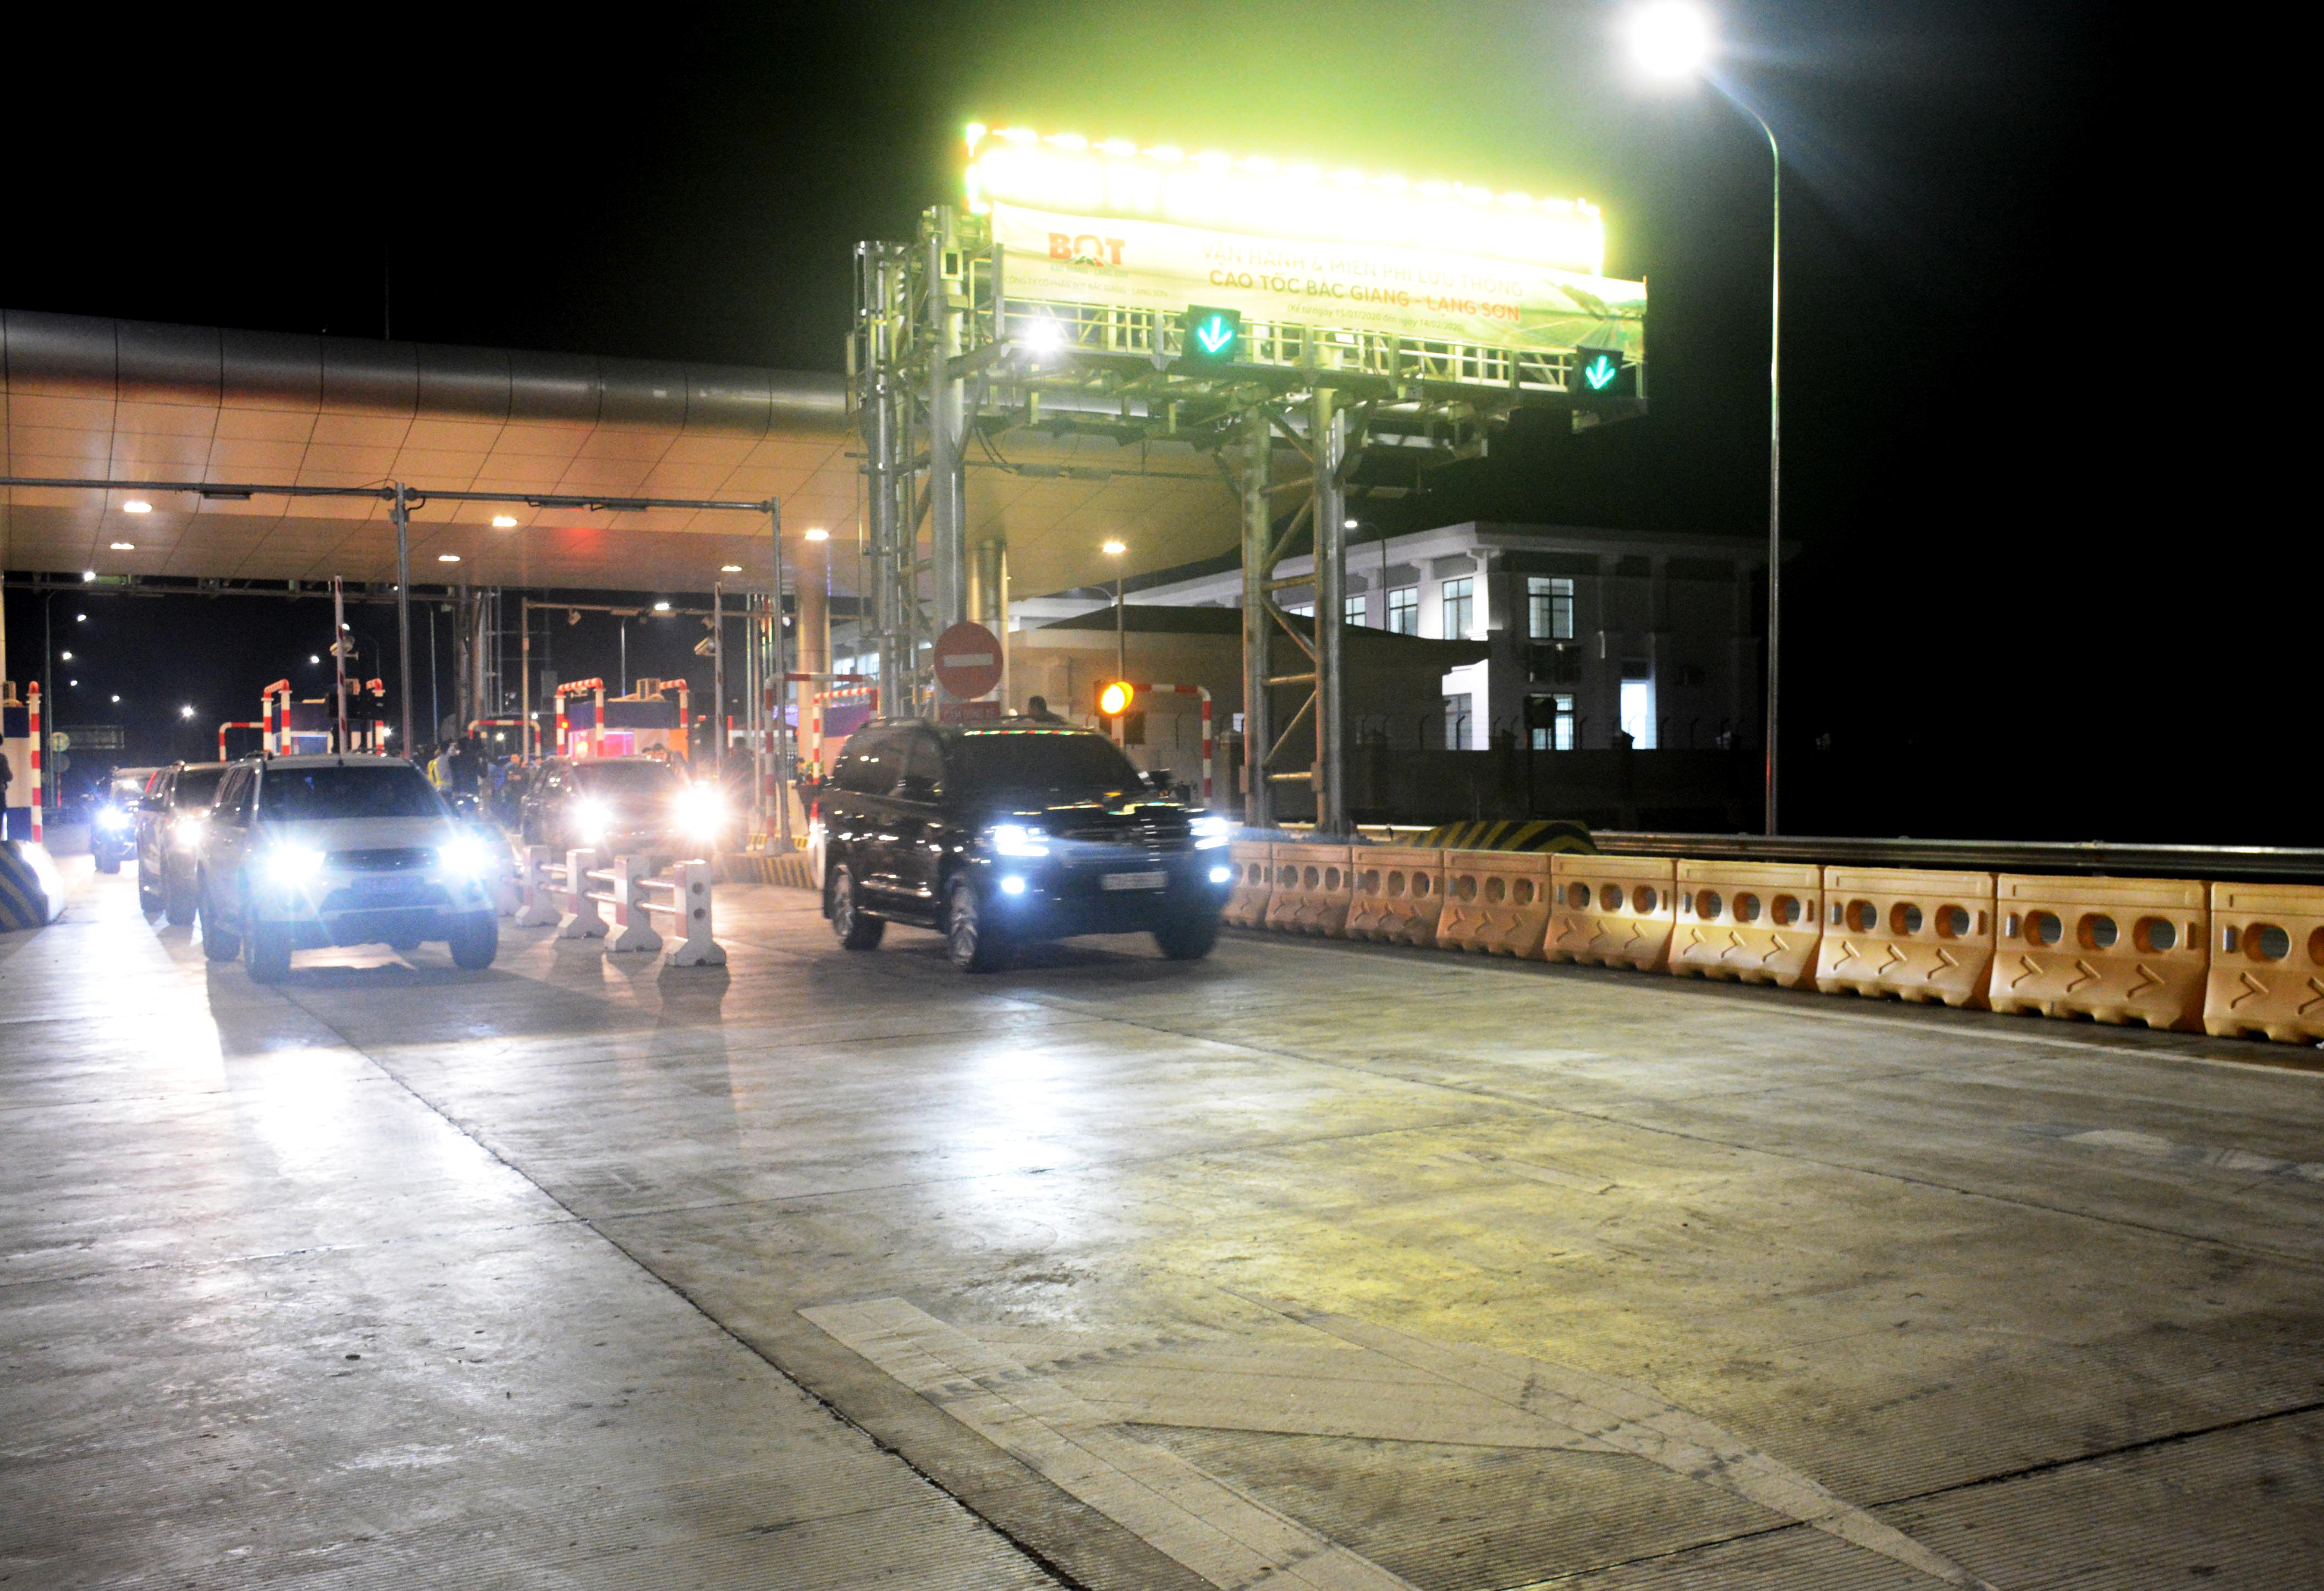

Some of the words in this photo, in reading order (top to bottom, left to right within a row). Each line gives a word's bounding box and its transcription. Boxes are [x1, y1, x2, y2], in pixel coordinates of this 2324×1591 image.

[1048, 232, 1126, 265] BOT
[1210, 269, 1254, 289] CAO
[1350, 285, 1410, 307] GIANG
[1427, 294, 1477, 317] LẠNG
[1481, 302, 1520, 322] SƠN
[1336, 308, 1381, 321] 15/01/2020
